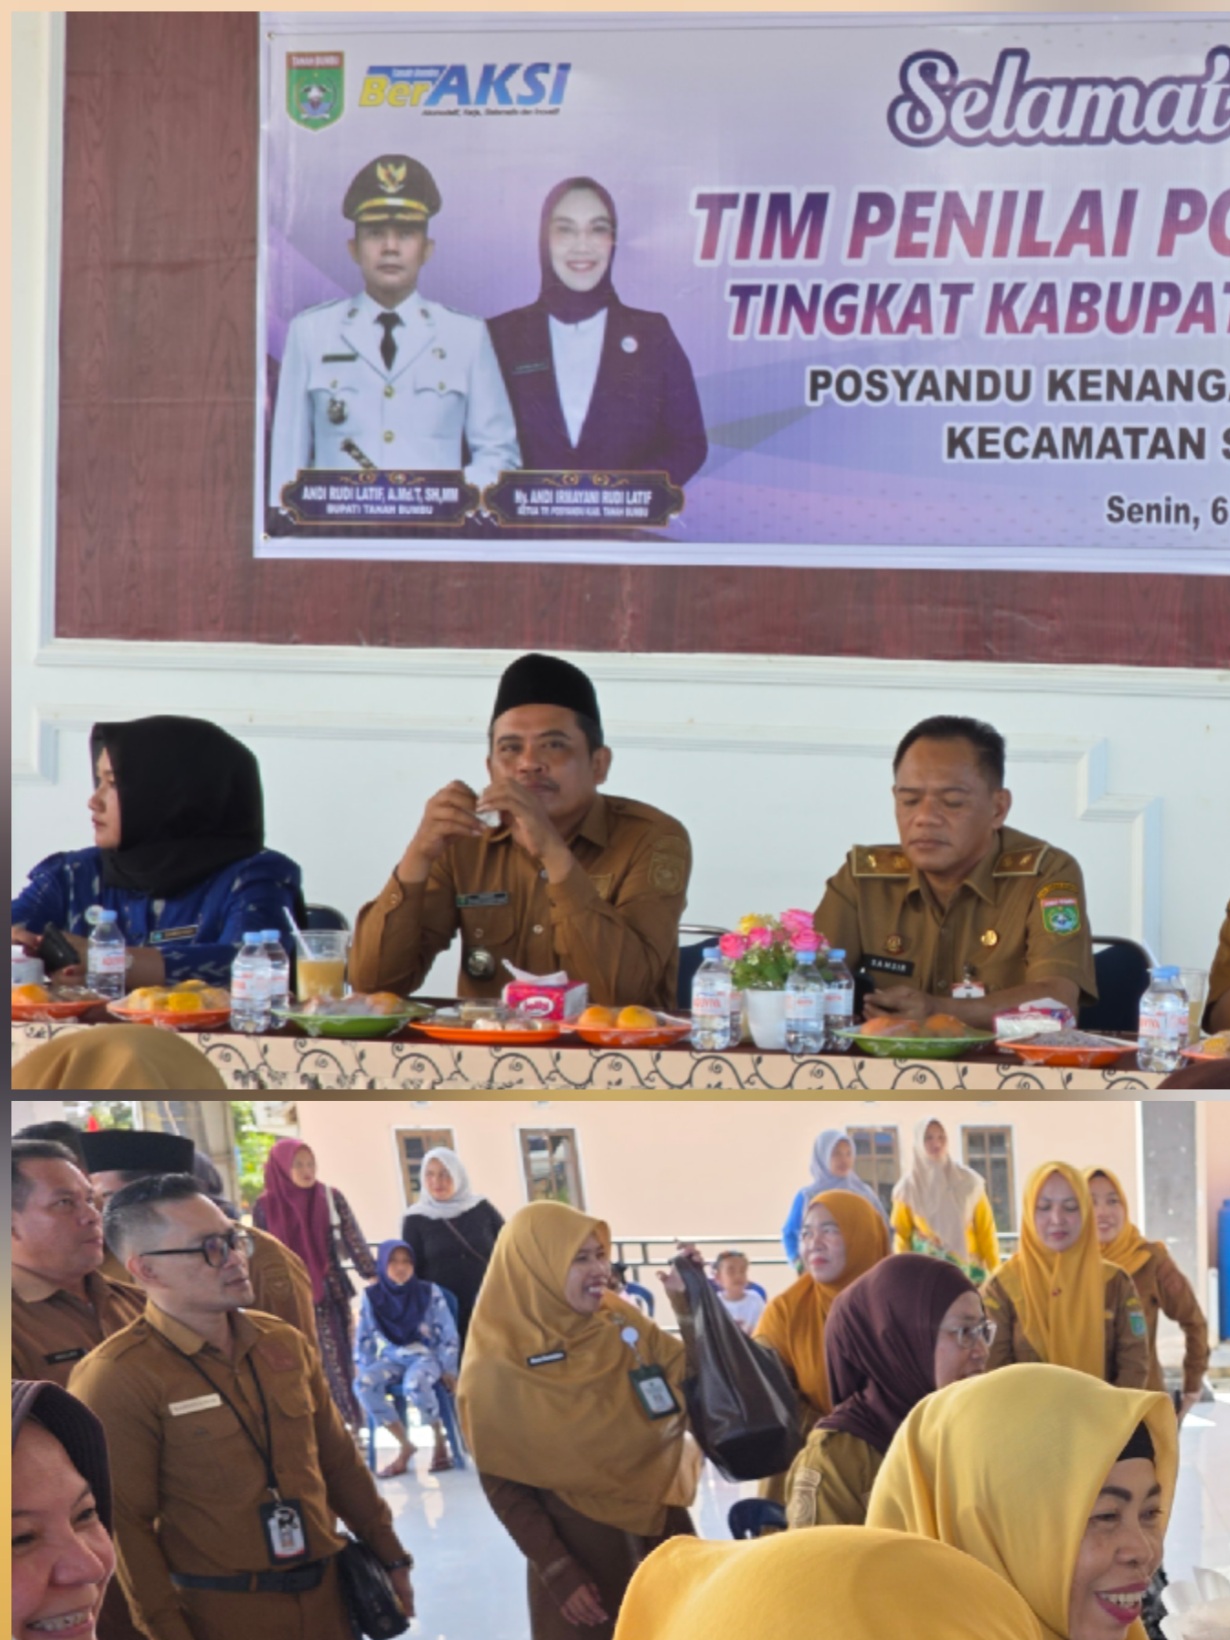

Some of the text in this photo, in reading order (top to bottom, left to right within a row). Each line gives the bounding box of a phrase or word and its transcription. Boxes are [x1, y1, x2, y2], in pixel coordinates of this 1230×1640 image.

[694, 190, 829, 260] TIM
[846, 188, 1139, 260] PENILAI
[729, 282, 974, 335] TINGKAT
[808, 368, 1032, 402] POSYANDU
[946, 425, 1206, 461] KECAMATAN
[1105, 494, 1201, 532] Senin,
[1210, 495, 1230, 526] 6
